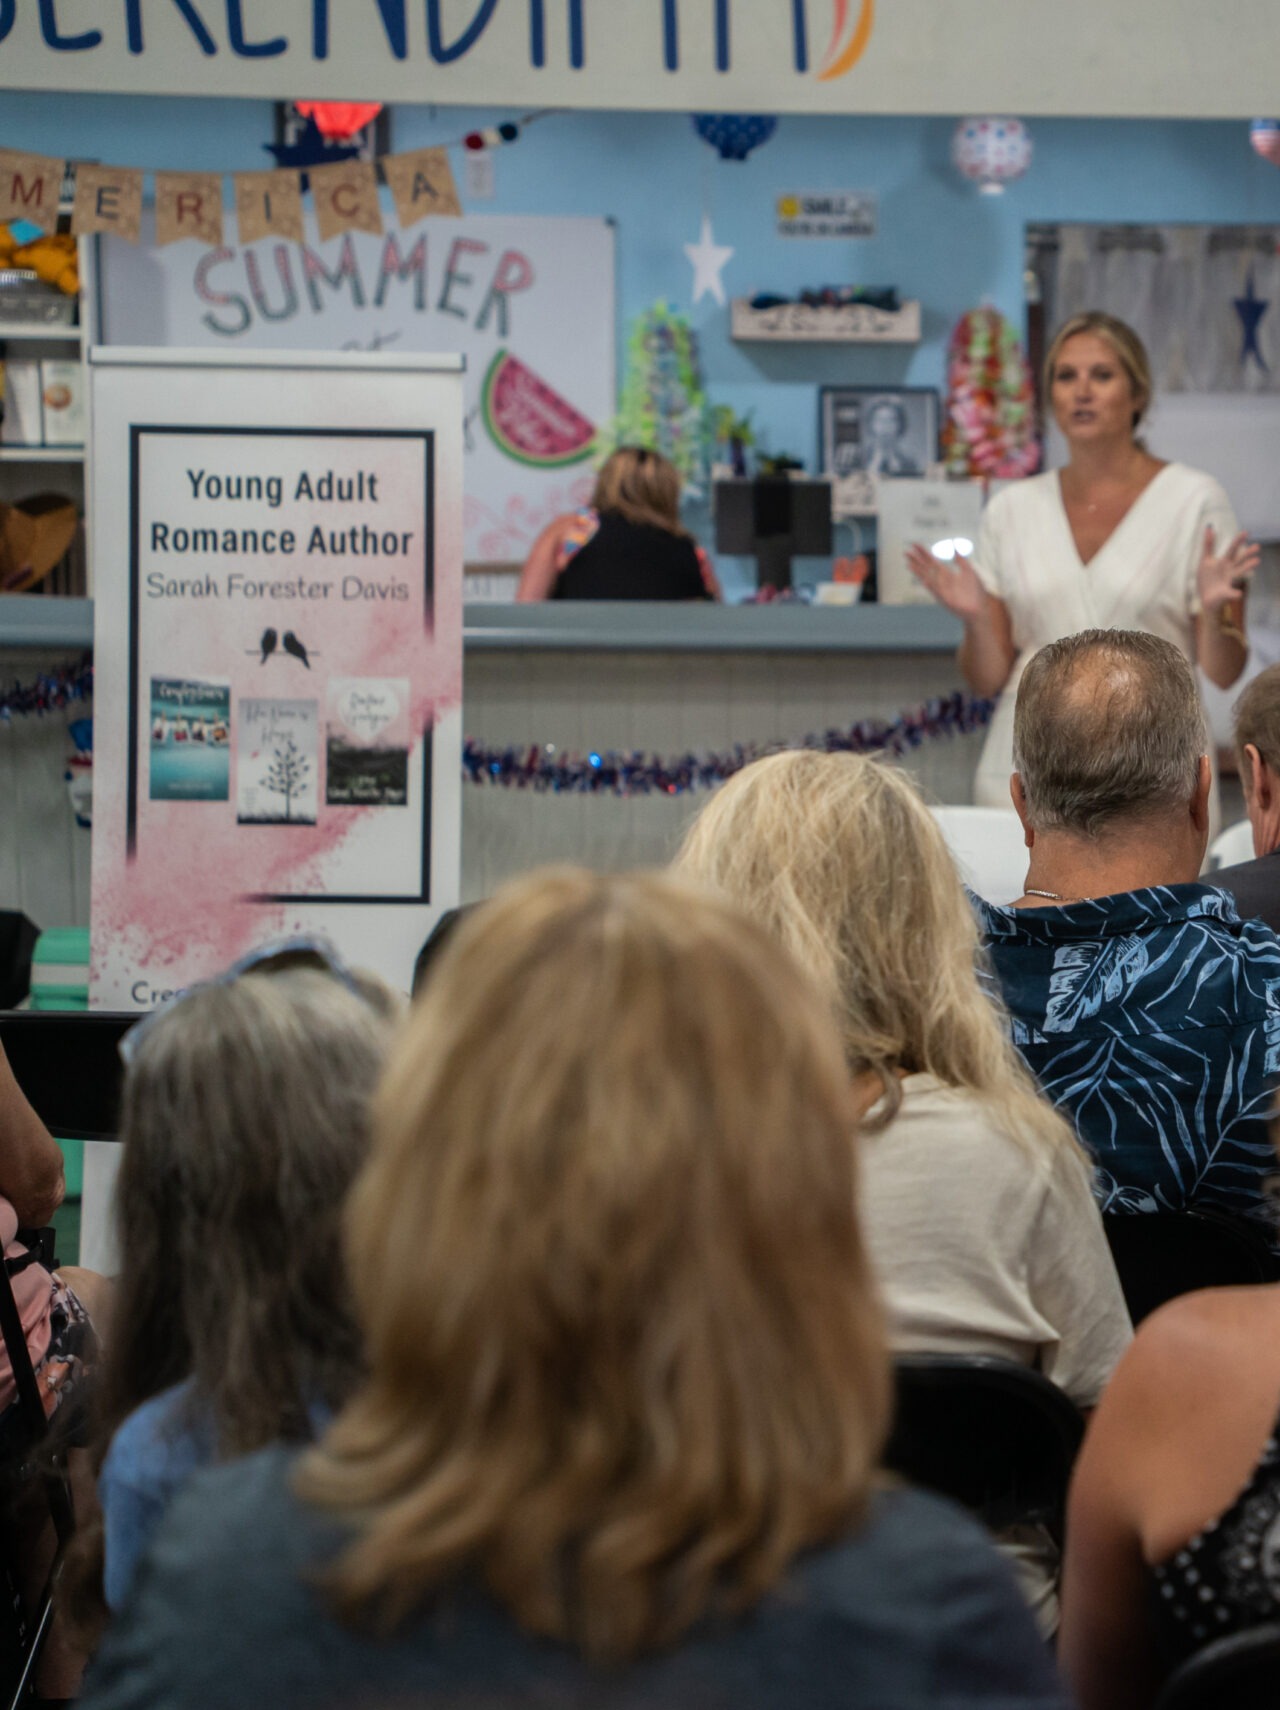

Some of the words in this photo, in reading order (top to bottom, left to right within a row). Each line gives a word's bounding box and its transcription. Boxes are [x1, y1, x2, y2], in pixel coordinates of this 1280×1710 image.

[193, 232, 534, 338] SUMMER
[187, 469, 283, 508] Young
[295, 470, 379, 502] Adult
[151, 522, 296, 554] Romance
[307, 524, 414, 556] Author
[146, 572, 219, 599] Sarah
[227, 573, 334, 601] Forester
[341, 576, 409, 601] Davis
